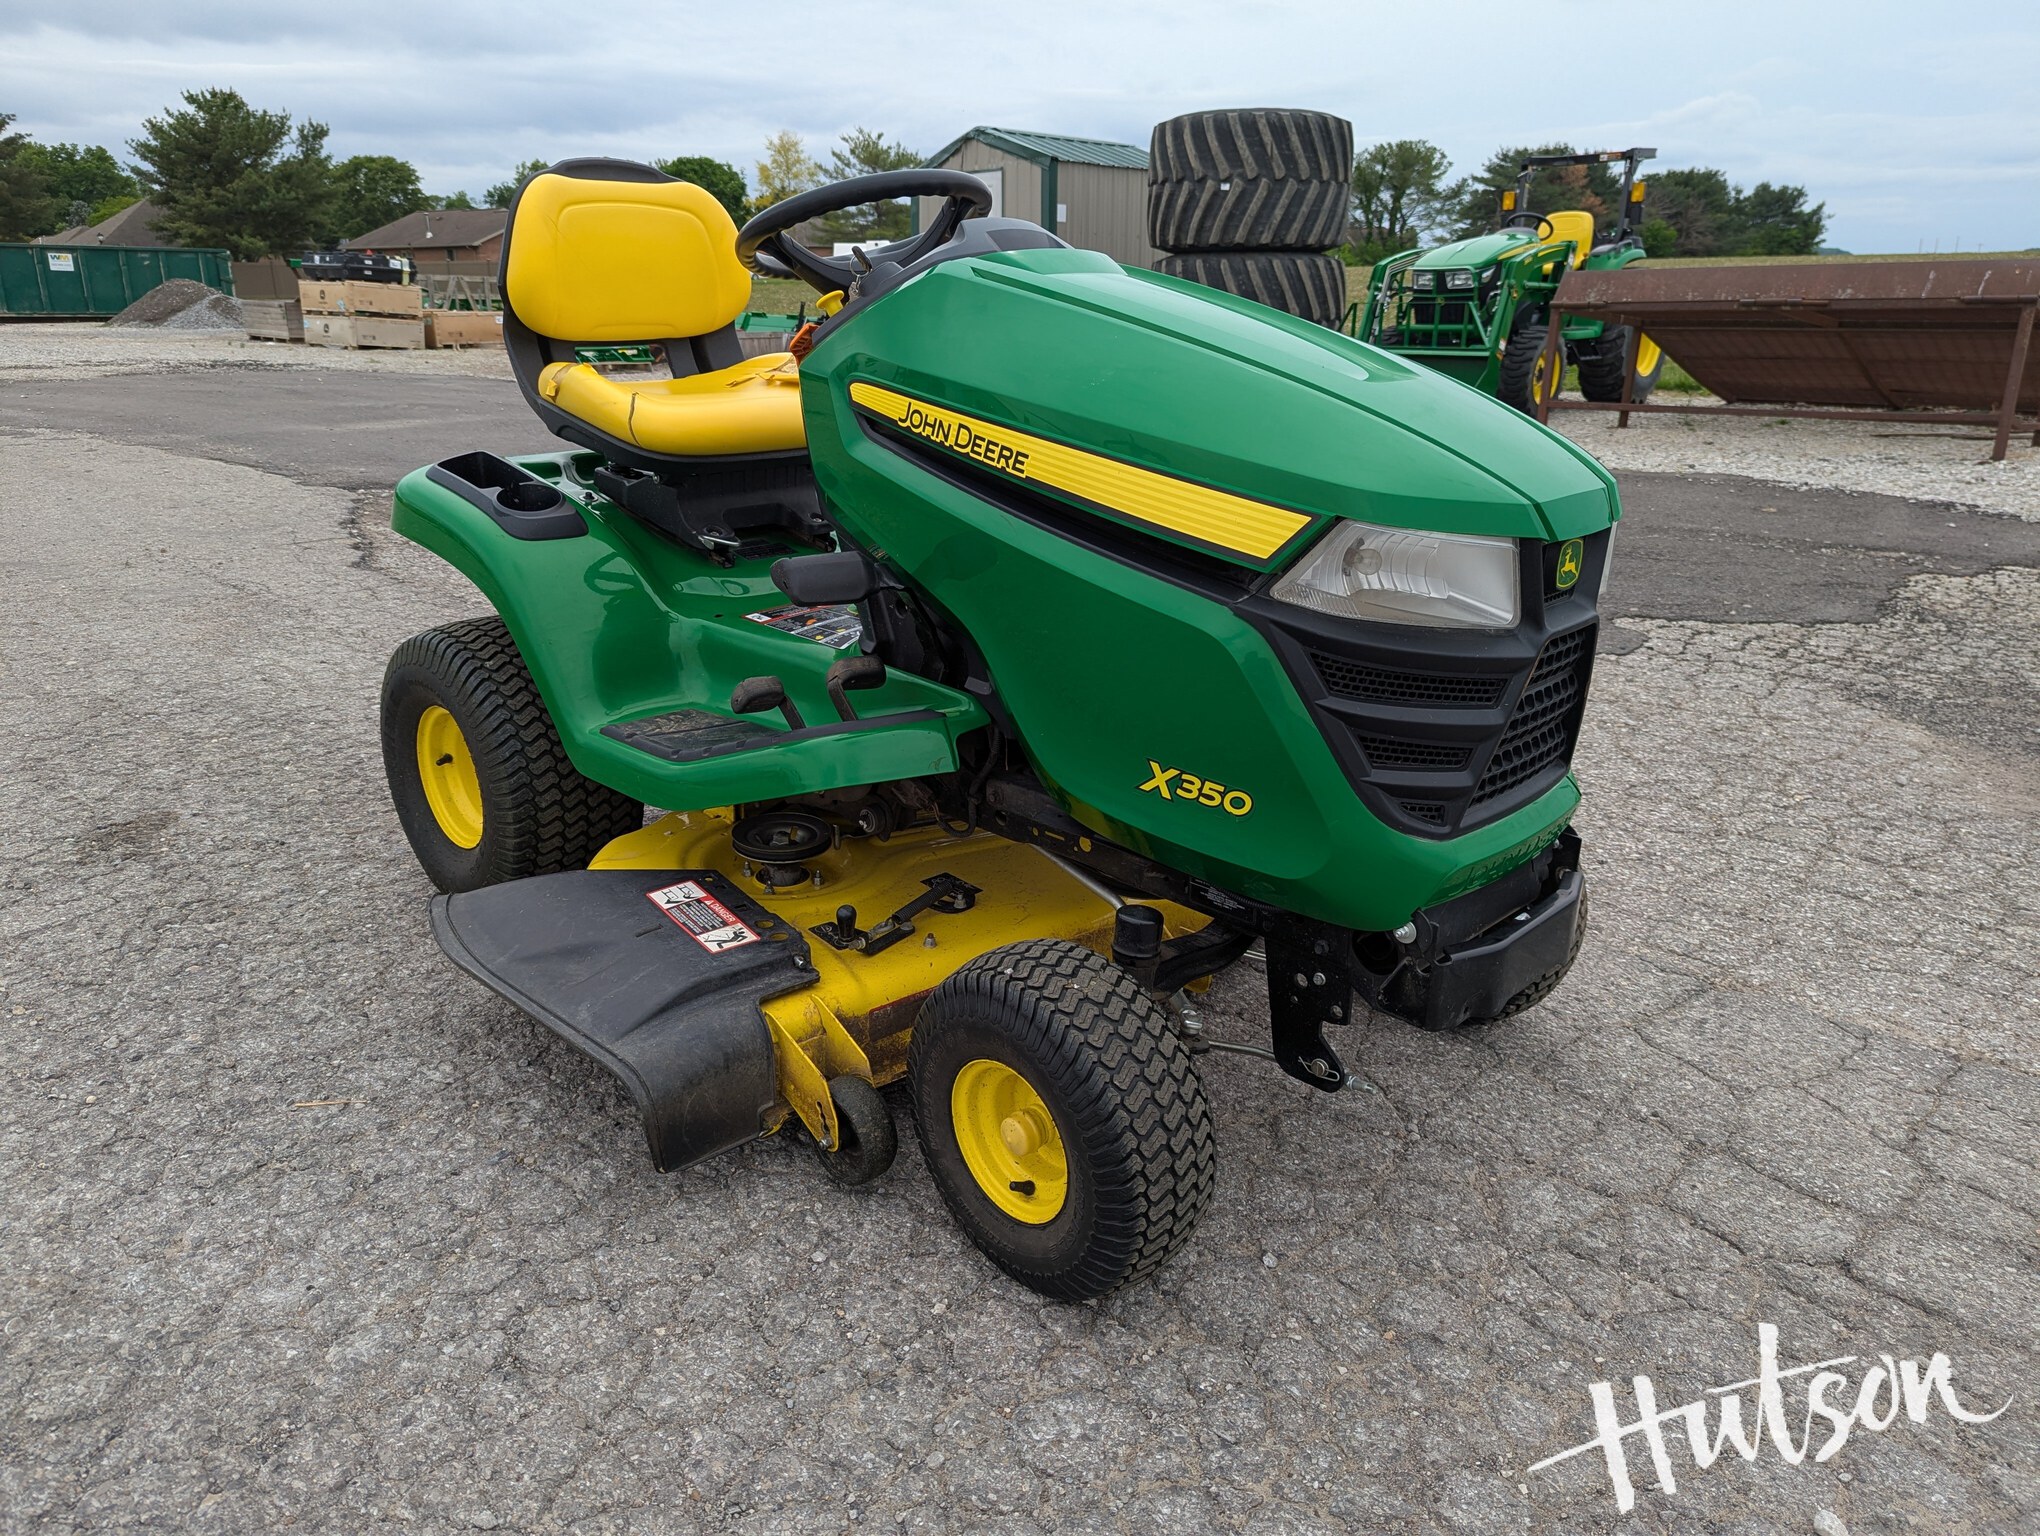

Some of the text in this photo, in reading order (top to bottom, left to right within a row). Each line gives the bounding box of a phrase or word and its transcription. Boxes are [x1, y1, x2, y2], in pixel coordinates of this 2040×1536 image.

[898, 401, 1030, 475] JOHN DEERE
[1138, 760, 1253, 816] X350
[710, 902, 737, 923] DANGER
